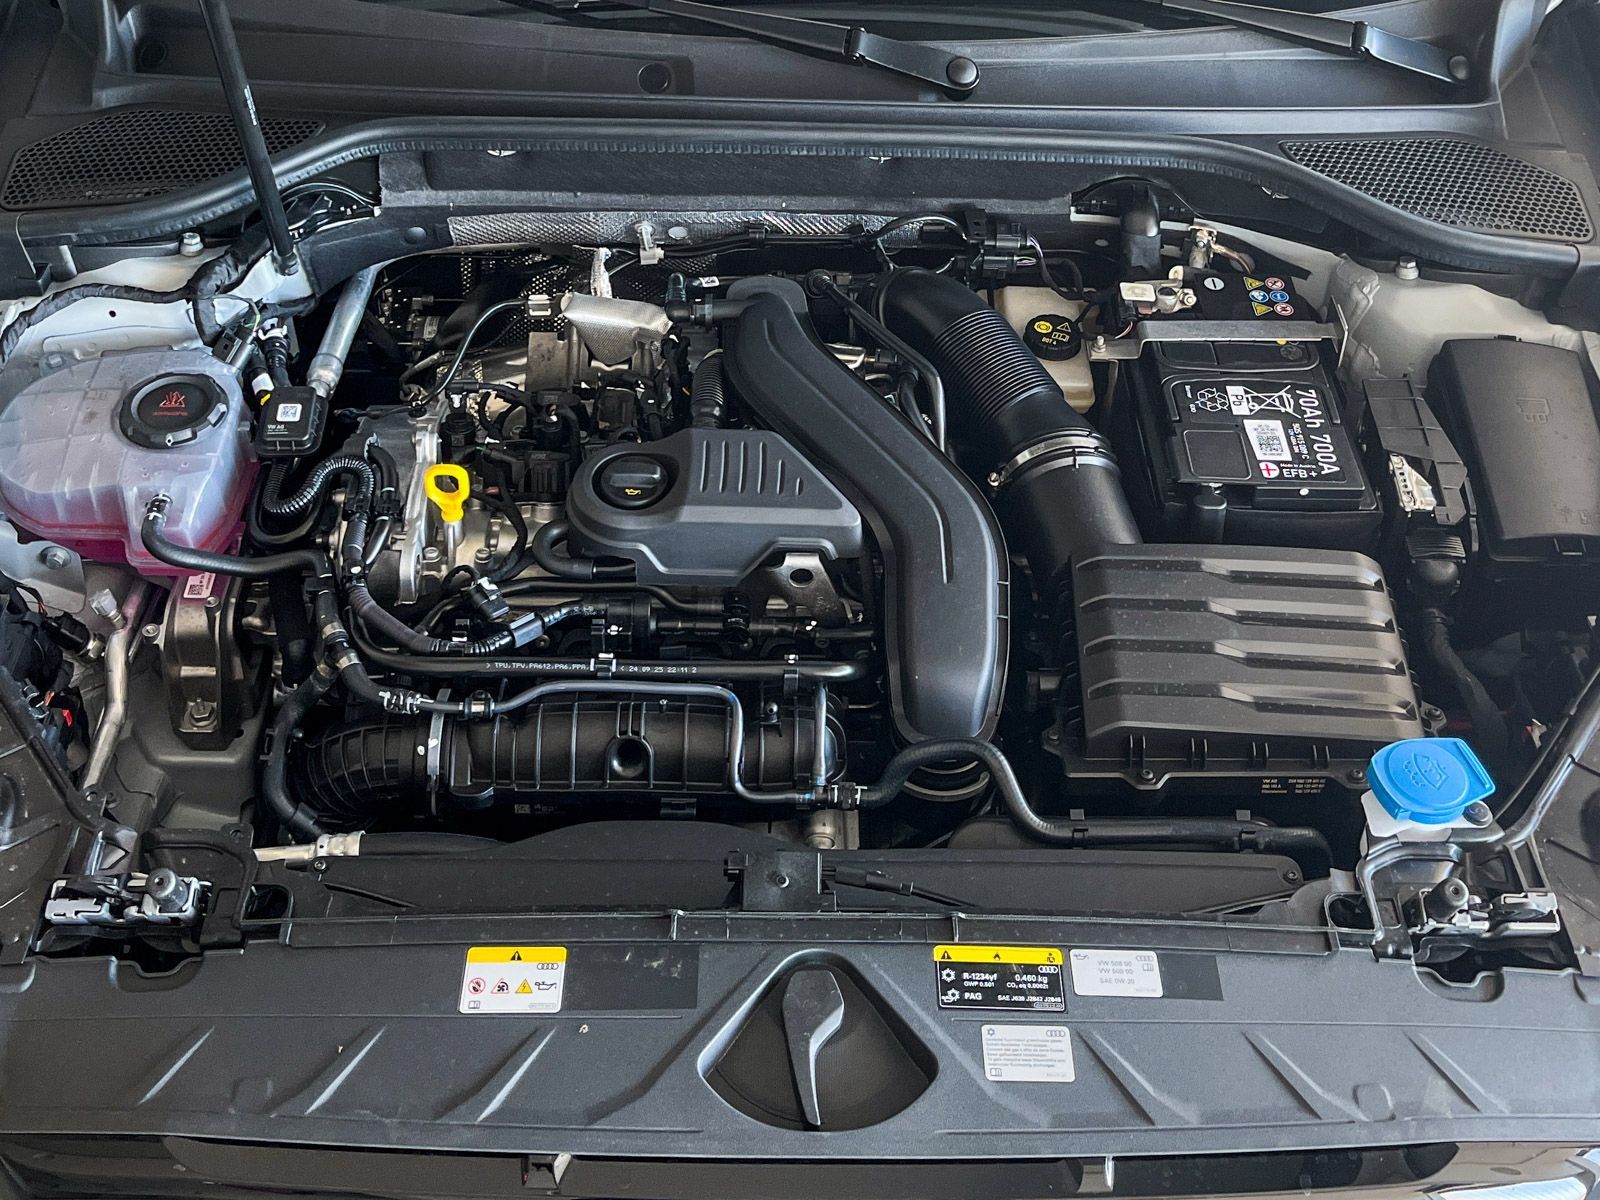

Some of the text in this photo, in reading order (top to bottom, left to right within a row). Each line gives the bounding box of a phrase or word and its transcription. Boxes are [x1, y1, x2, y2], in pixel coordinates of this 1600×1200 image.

[1231, 394, 1245, 406] Pb
[1296, 389, 1340, 475] 70Ah 700A
[1282, 468, 1308, 478] EFB
[963, 972, 1048, 984] R-1234yf 0.460 kg
[964, 992, 982, 1000] PAG
